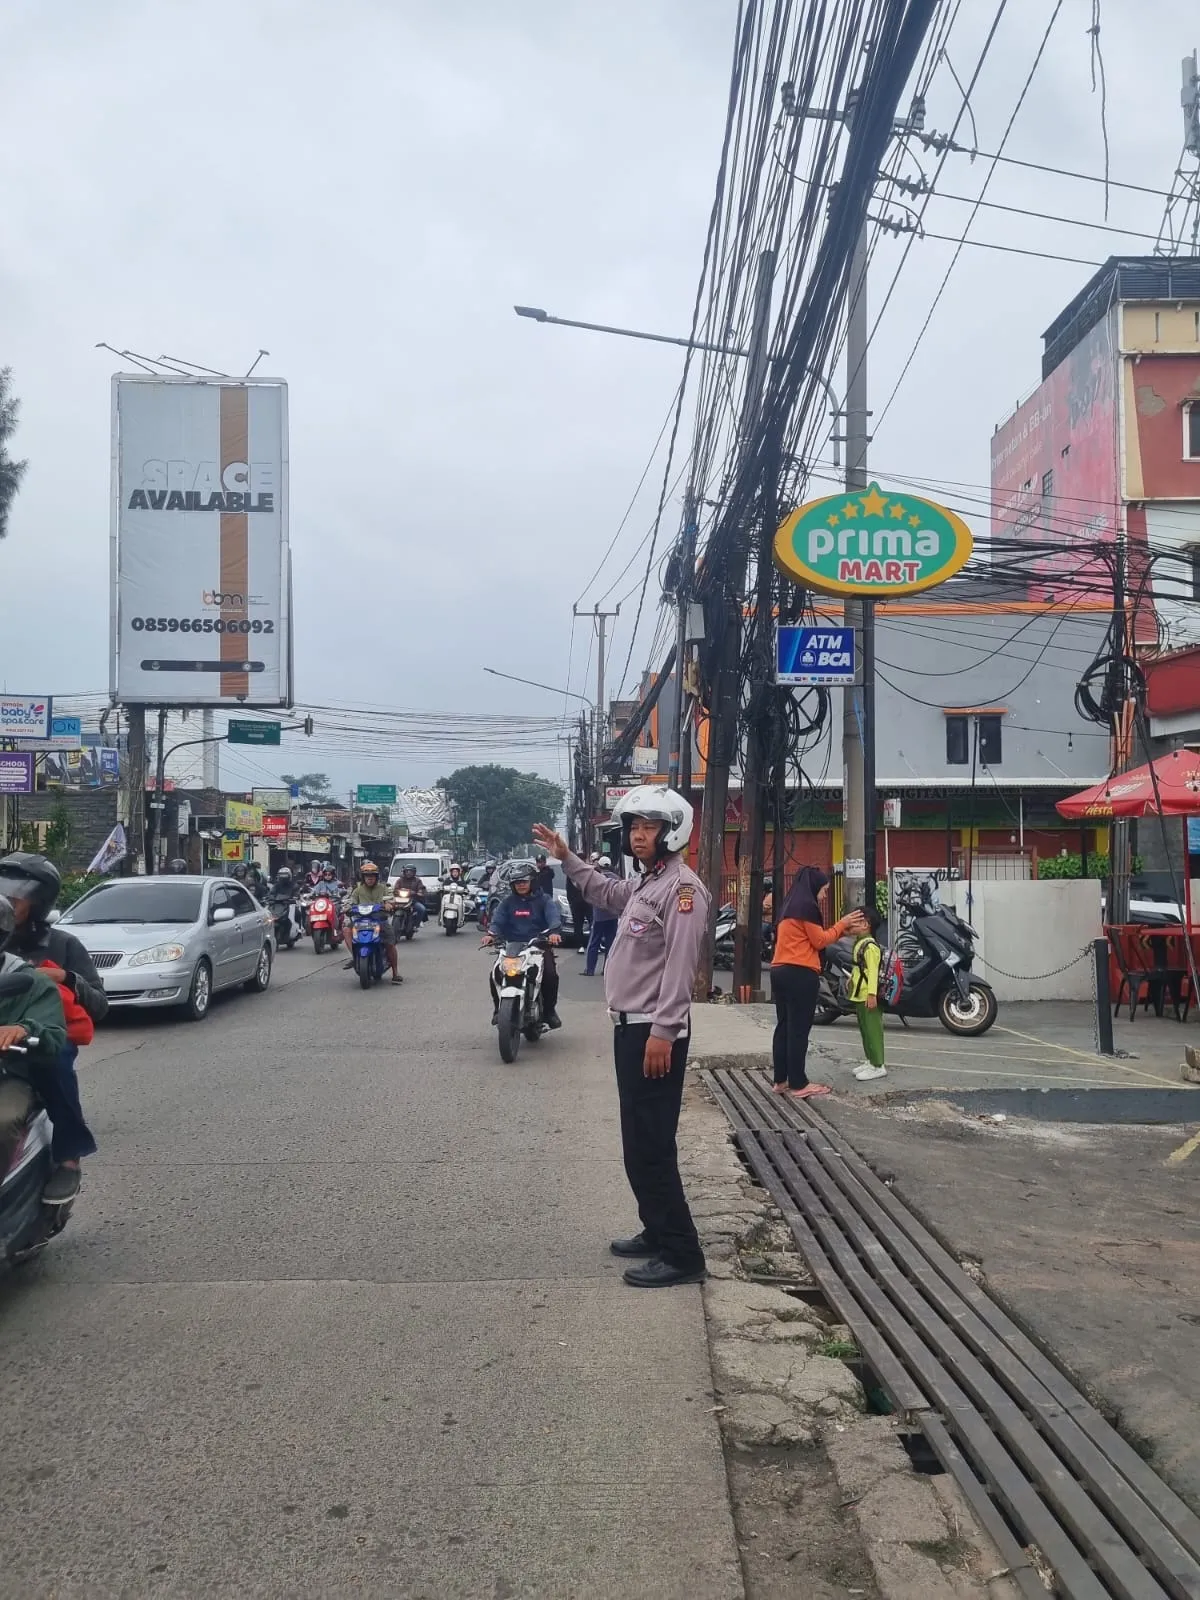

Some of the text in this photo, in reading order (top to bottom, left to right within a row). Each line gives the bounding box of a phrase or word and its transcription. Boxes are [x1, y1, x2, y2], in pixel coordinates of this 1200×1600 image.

[142, 459, 273, 491] SPACE
[128, 489, 274, 512] AVAILABLE
[808, 529, 939, 563] prima
[838, 559, 921, 583] MART
[131, 617, 274, 633] 085966506092
[806, 634, 842, 650] ATM
[818, 651, 850, 667] BCA
[1, 707, 31, 718] baby
